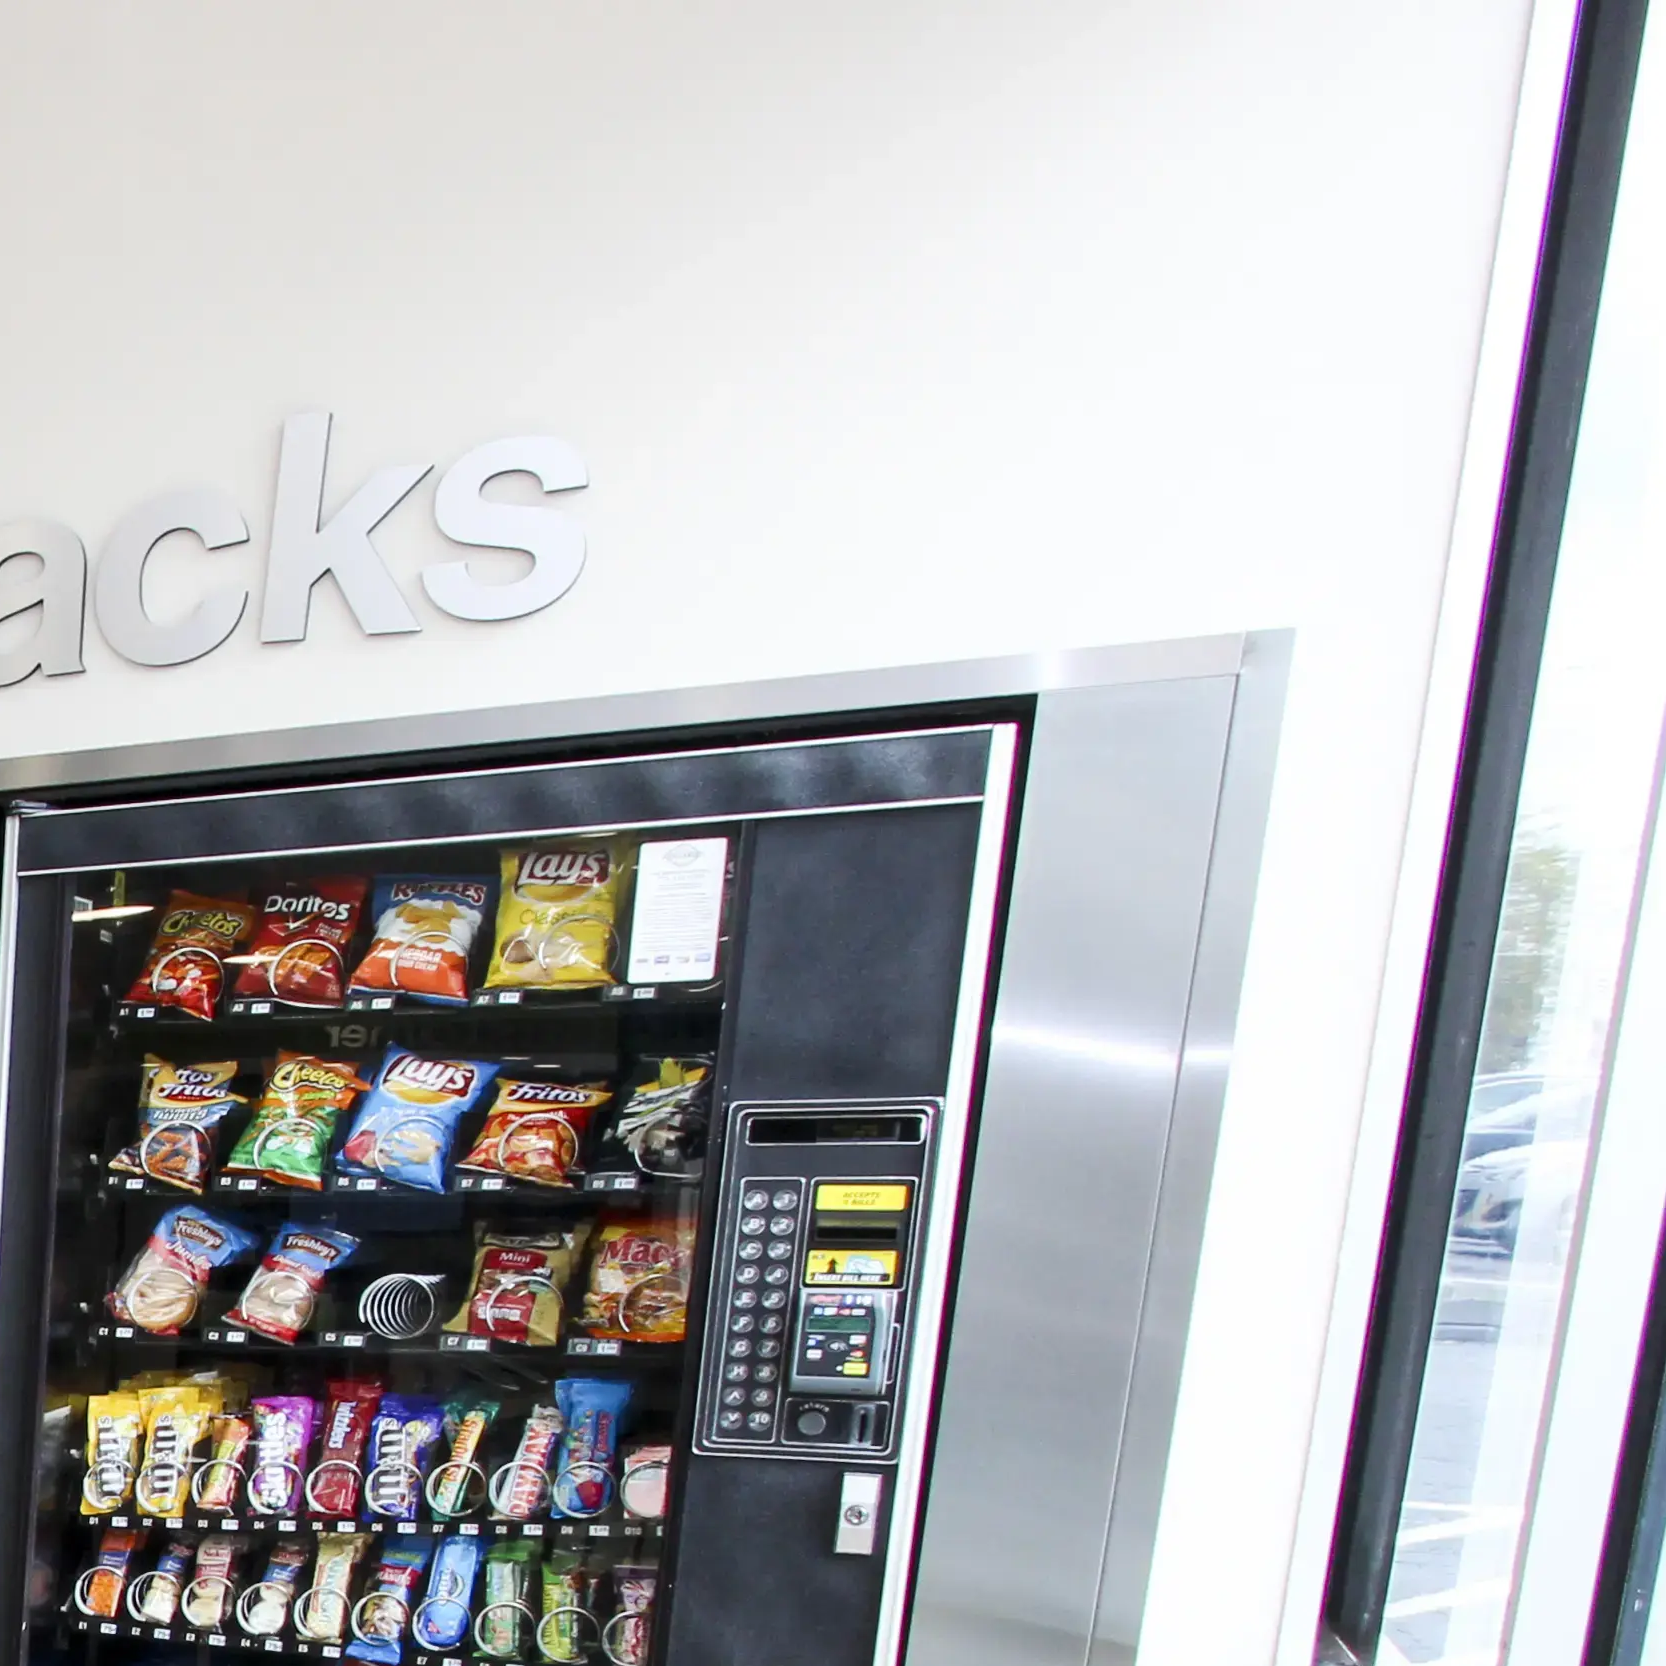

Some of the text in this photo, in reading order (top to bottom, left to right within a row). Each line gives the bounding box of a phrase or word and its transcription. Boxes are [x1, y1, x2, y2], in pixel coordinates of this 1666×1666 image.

[264, 895, 351, 921] Doritos
[161, 910, 240, 935] Chetos
[271, 1062, 349, 1091] Cheetos
[508, 1082, 591, 1103] Fritos
[499, 1251, 531, 1264] Mini
